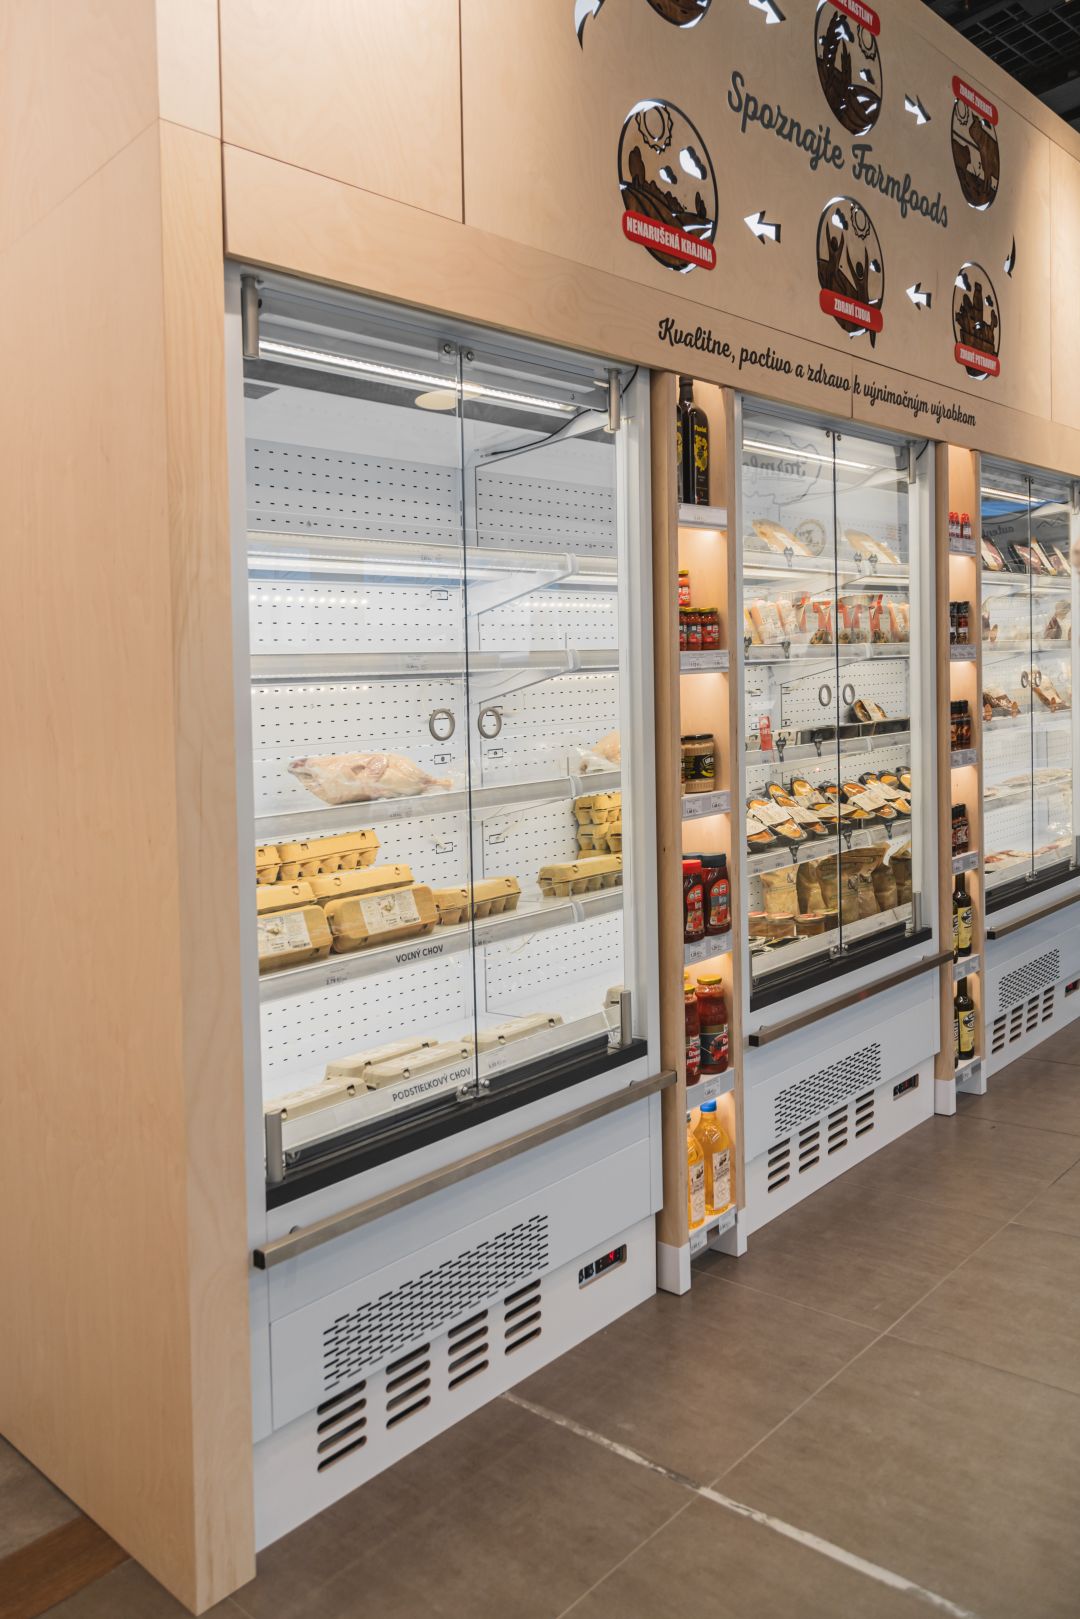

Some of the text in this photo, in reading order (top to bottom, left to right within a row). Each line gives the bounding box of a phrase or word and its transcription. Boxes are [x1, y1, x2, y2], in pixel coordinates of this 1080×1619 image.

[727, 71, 948, 228] Spoznajte Farmfoods
[626, 216, 713, 263] NENARUŠENÁ KRAJINA
[658, 317, 977, 427] Kvalitne, poctivo a zdravo k výnimočným výrobkom
[395, 944, 444, 963] VOĽNÝ CHOV
[392, 1067, 471, 1102] PODSTIEĽKOVÝ CHOV
